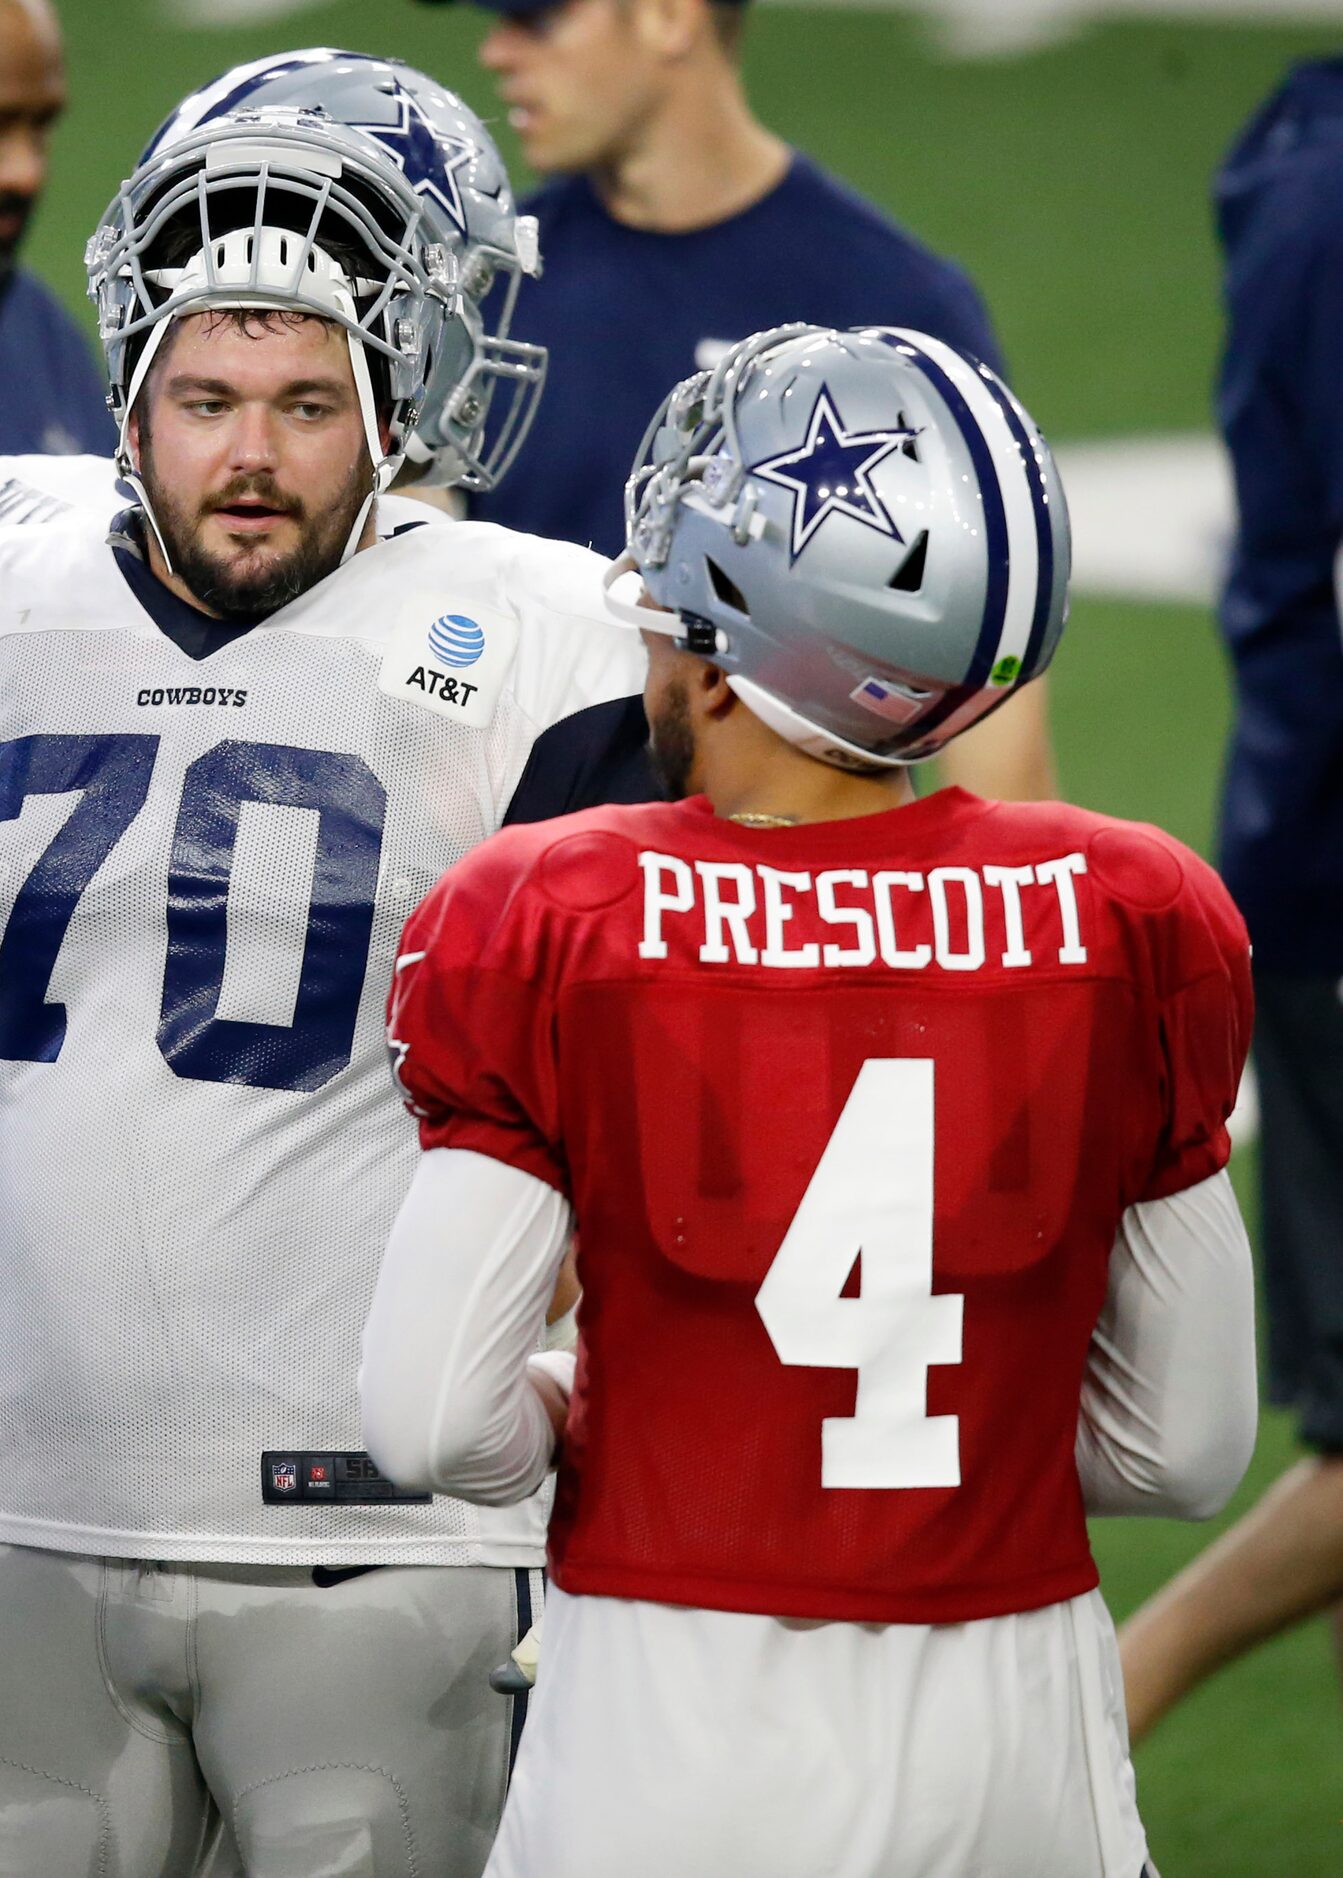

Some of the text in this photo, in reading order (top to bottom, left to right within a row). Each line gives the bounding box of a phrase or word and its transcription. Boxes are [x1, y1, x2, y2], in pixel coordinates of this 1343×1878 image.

[137, 687, 248, 708] COWBOYS
[405, 665, 478, 707] AT&T
[637, 851, 1088, 972] PRESCOTT
[754, 1057, 965, 1490] 4
[274, 1475, 294, 1489] NFL
